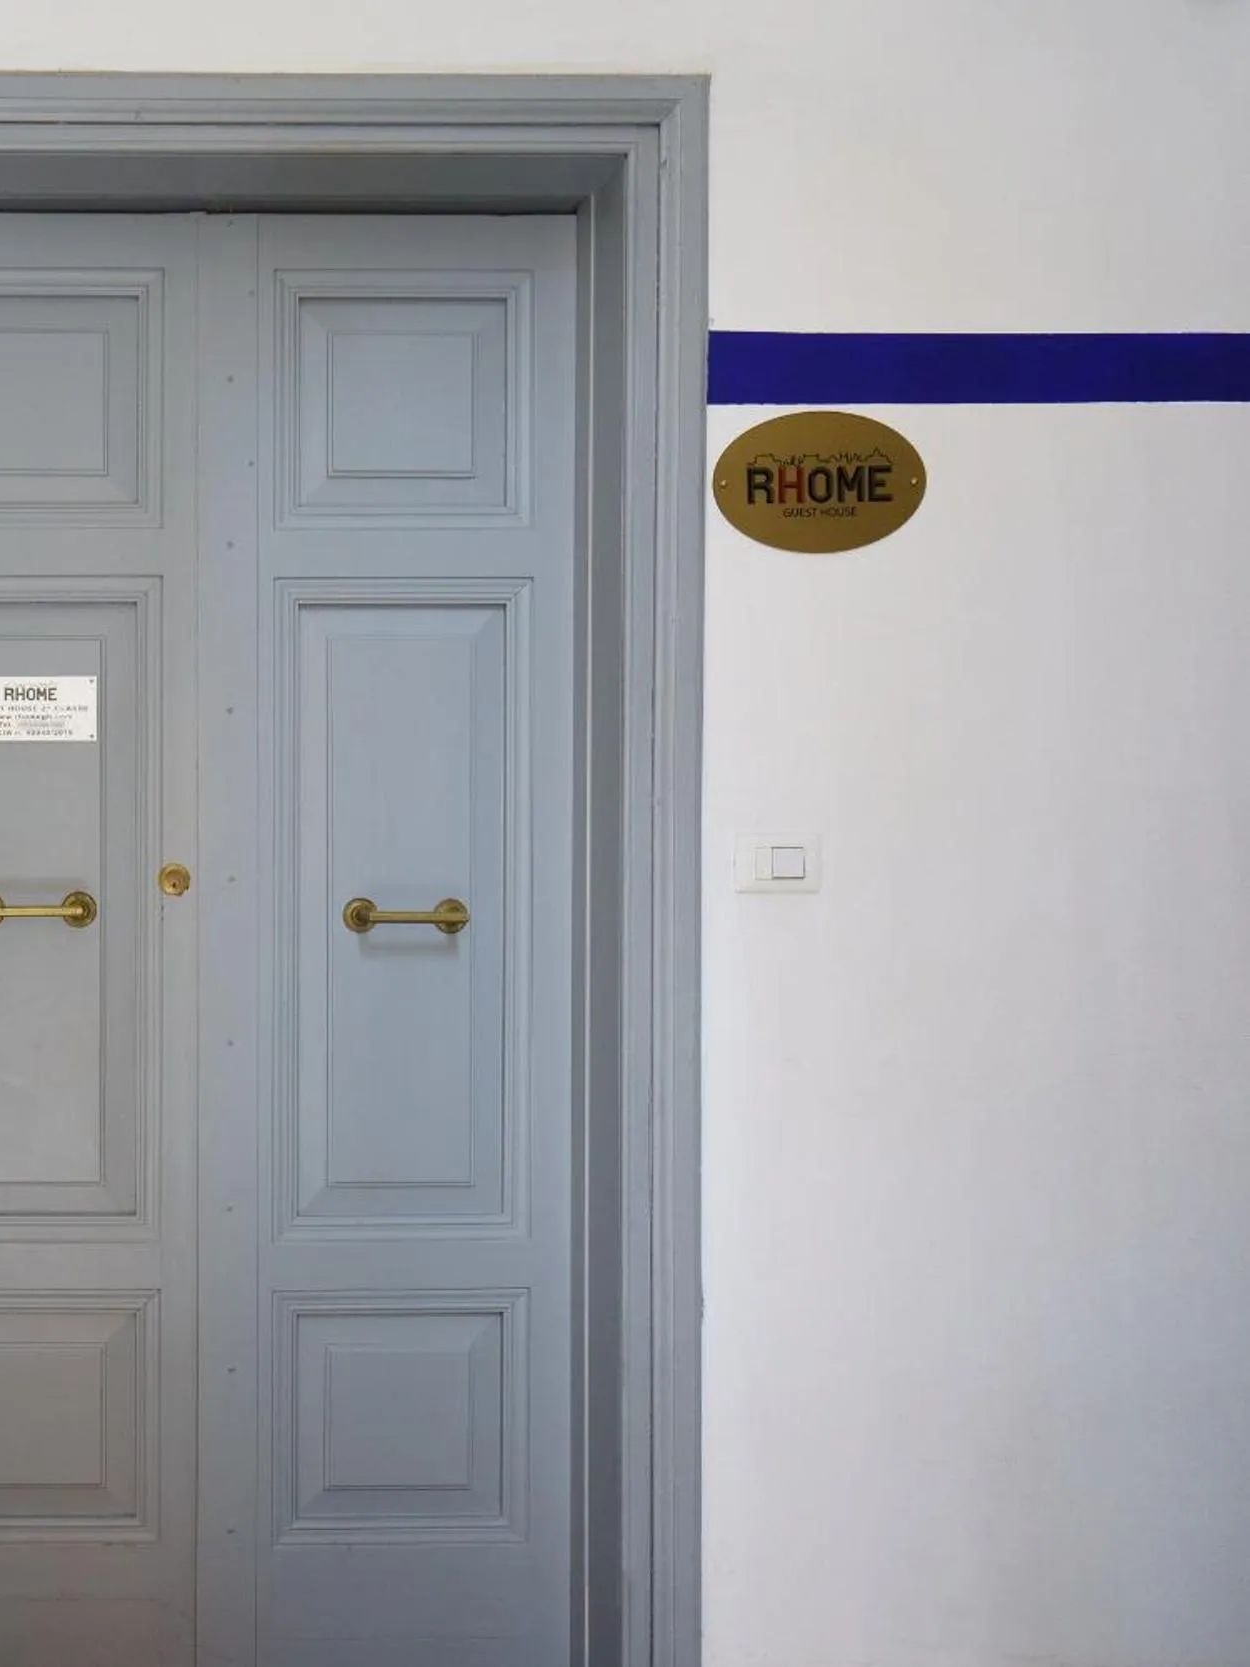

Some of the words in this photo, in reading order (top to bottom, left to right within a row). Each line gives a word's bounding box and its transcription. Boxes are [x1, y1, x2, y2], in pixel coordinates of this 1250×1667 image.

[747, 466, 894, 505] RHOME
[783, 508, 816, 518] GUEST
[820, 507, 857, 518] HOUSE
[4, 687, 58, 701] RHOME
